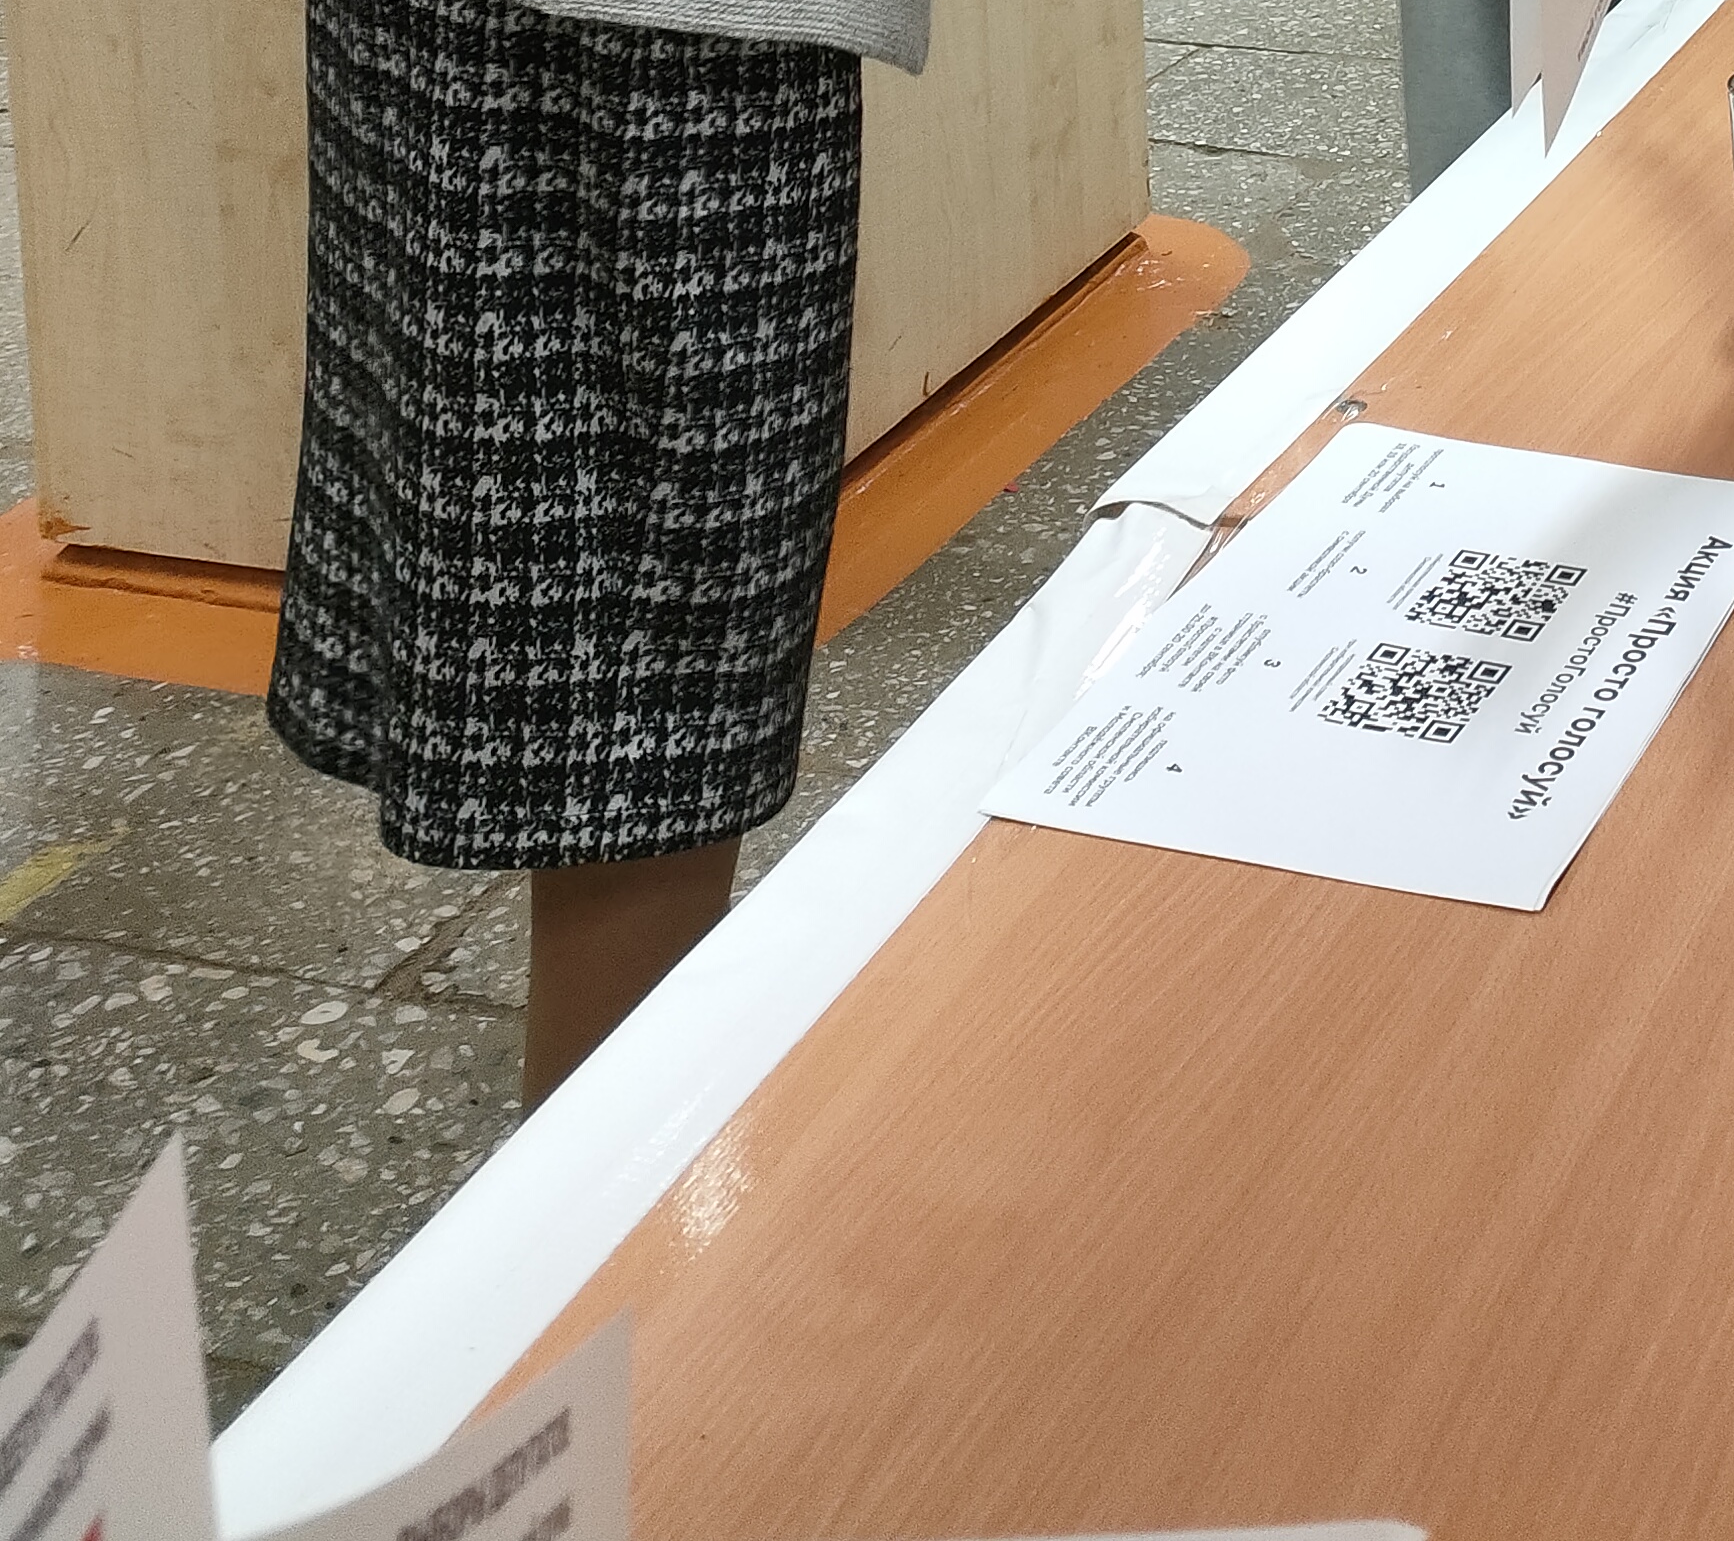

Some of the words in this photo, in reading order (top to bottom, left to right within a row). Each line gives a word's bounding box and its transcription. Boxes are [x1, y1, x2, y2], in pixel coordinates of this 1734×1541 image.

[1427, 481, 1446, 489] 1
[1348, 565, 1368, 574] 2
[1664, 535, 1733, 602] Акция
[1260, 658, 1283, 668] 3
[1514, 592, 1638, 734] #ПростоГолосуй
[1593, 605, 1677, 702] «Просто
[1163, 762, 1186, 773] 4
[1507, 707, 1607, 820] голосуй»
